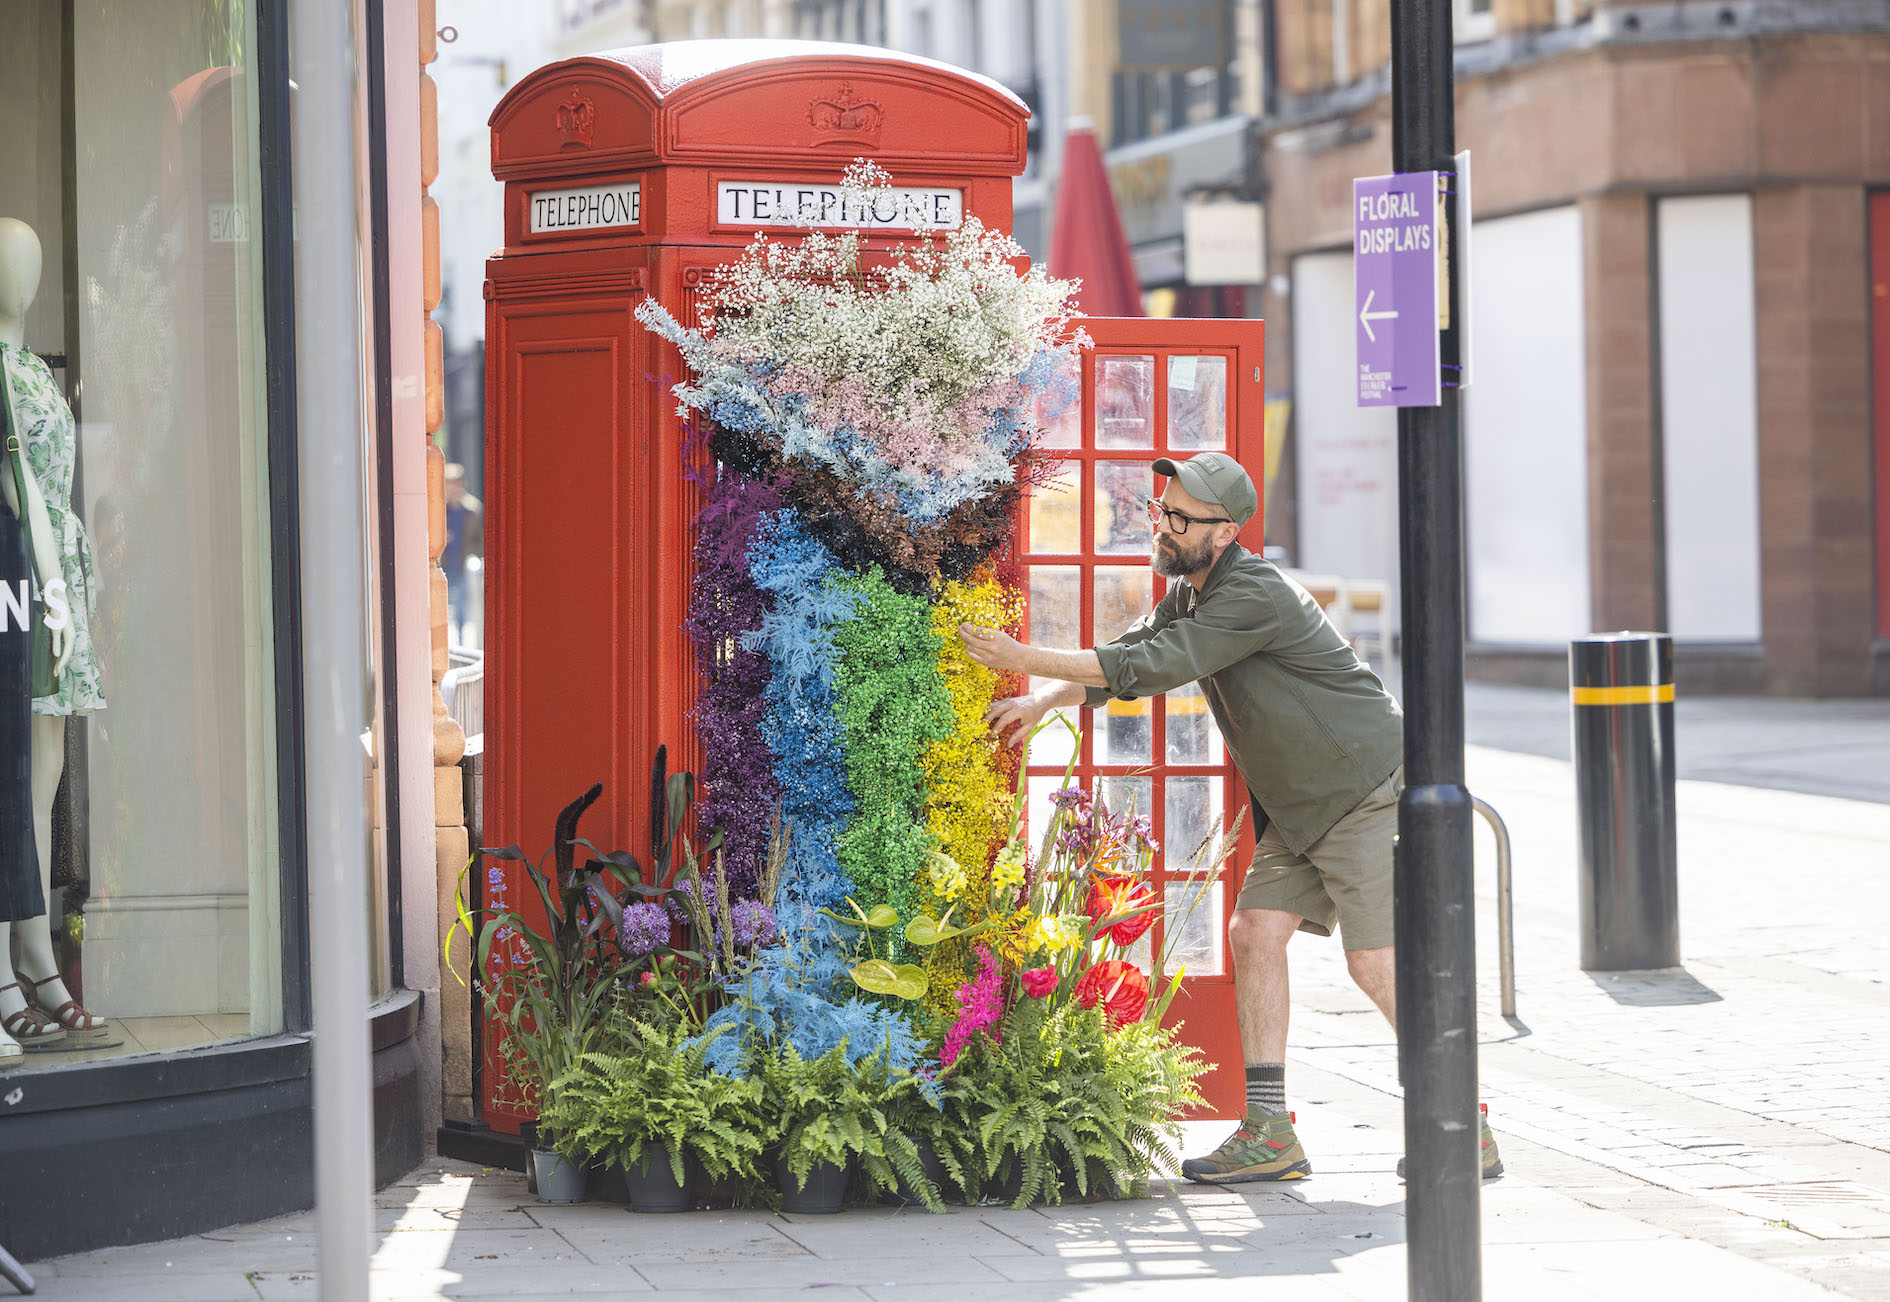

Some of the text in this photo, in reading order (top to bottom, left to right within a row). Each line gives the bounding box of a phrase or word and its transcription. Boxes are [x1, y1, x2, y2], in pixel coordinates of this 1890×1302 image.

[535, 191, 640, 228] TELEPHONE
[1359, 193, 1419, 222] FLORAL
[1359, 224, 1430, 254] DISPLAYS
